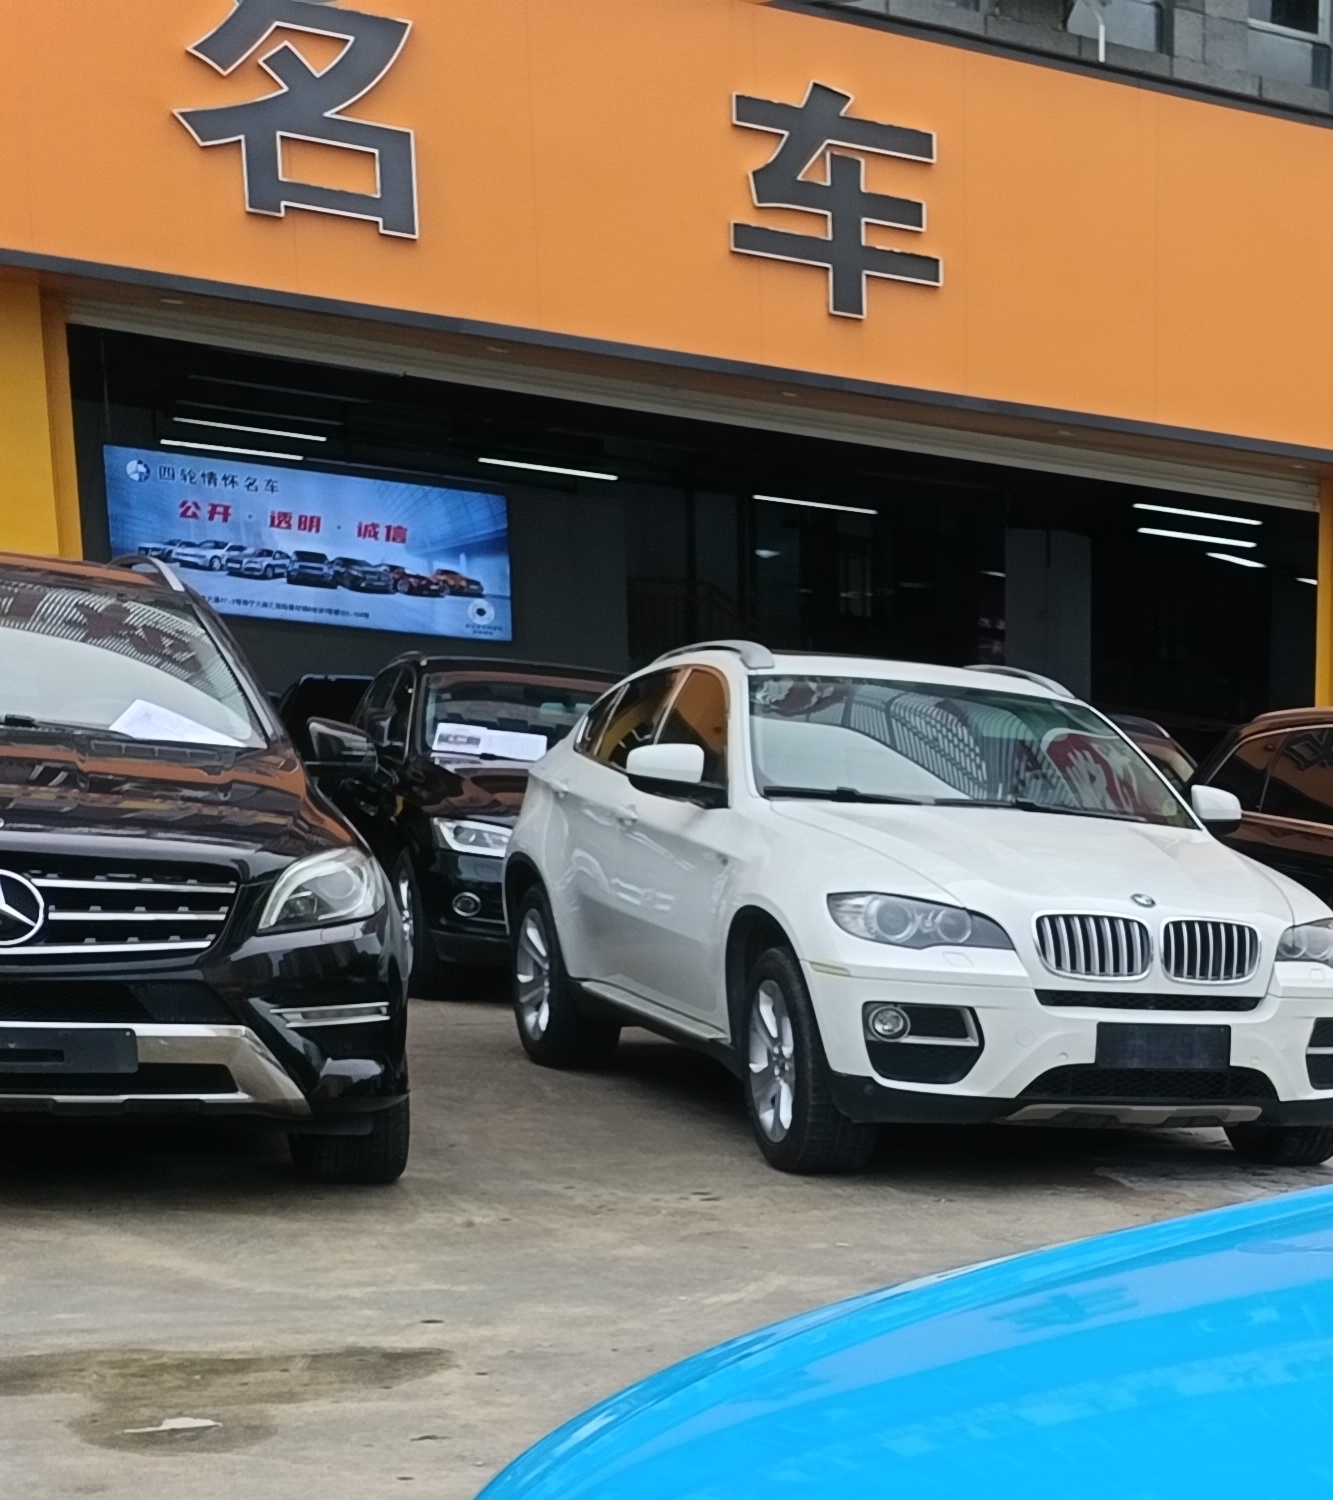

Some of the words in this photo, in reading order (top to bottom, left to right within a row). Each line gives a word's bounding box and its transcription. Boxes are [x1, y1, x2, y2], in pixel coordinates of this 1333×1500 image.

[158, 465, 279, 494] 四轮情怀名车
